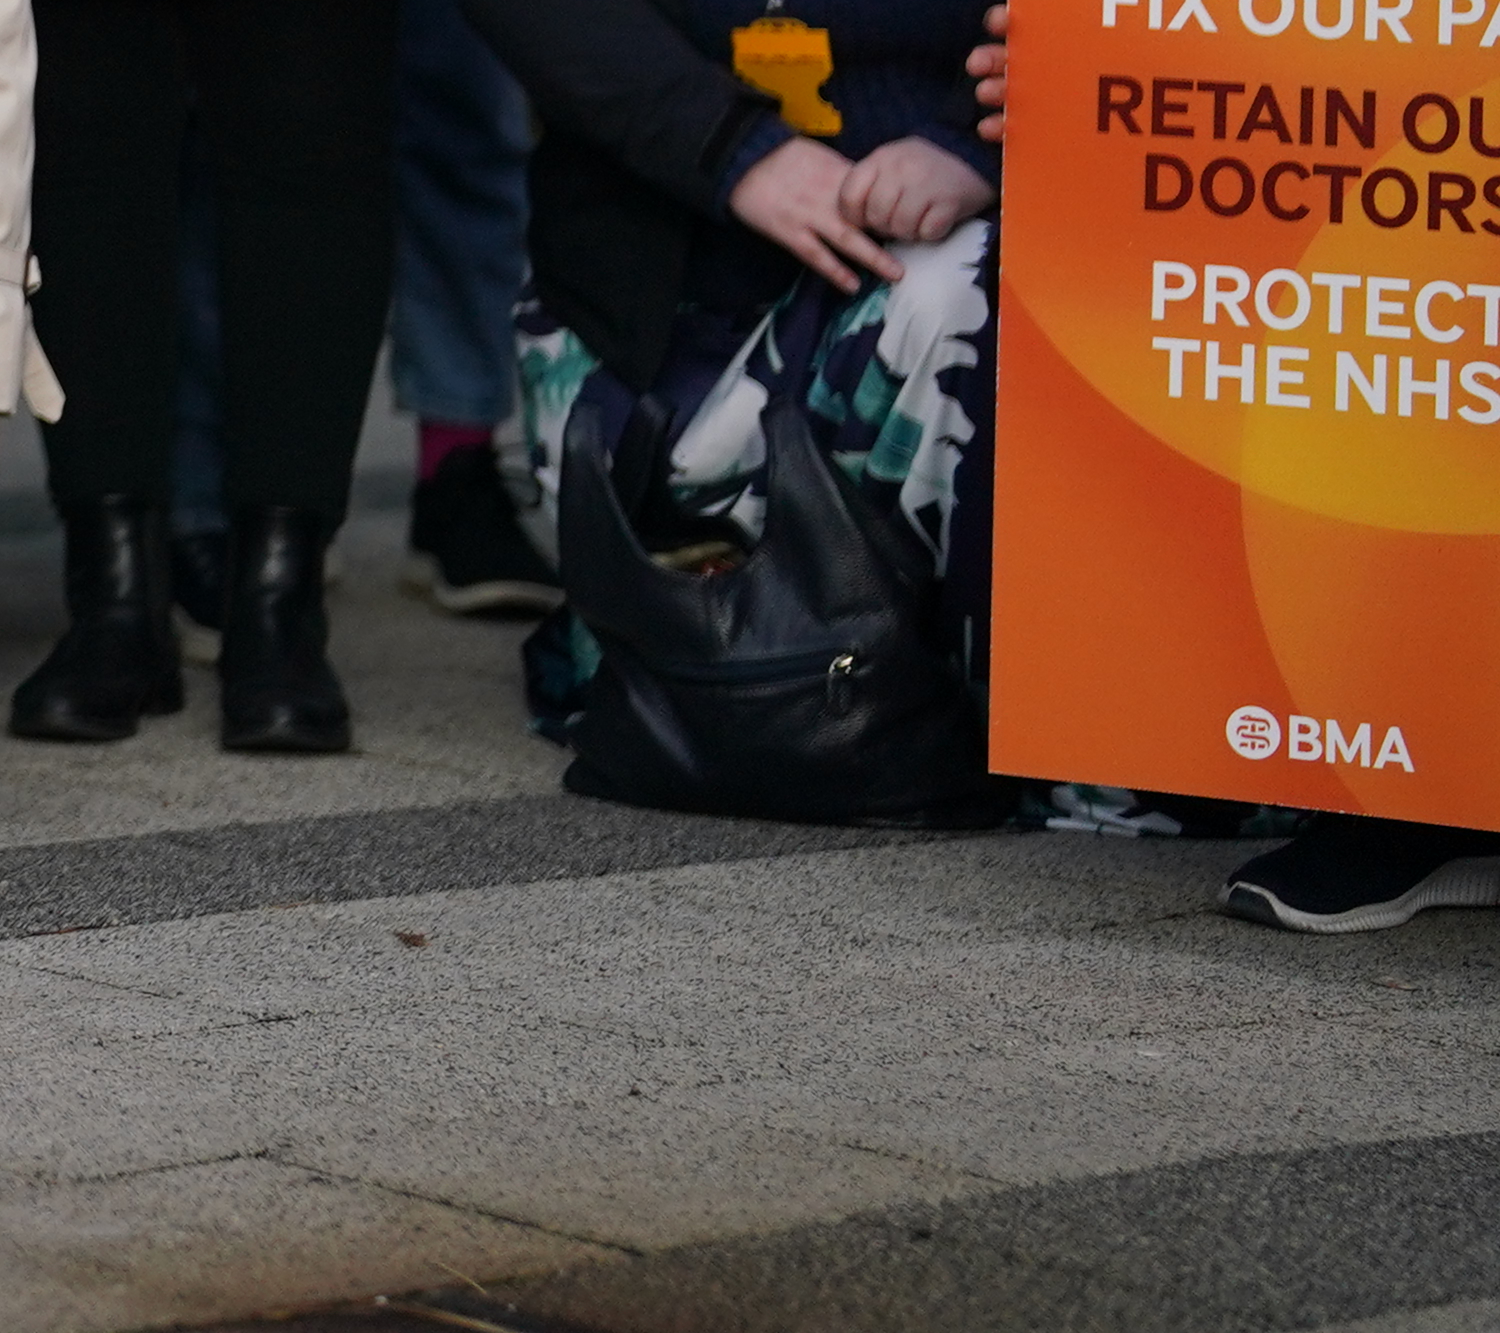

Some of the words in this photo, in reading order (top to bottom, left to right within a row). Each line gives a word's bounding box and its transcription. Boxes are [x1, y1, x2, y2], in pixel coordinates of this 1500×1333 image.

[1097, 74, 1376, 150] RETAIN
[1151, 259, 1500, 347] PROTECT
[1151, 337, 1311, 409] THE
[1334, 351, 1500, 425] NHS
[1288, 715, 1415, 774] BMA
